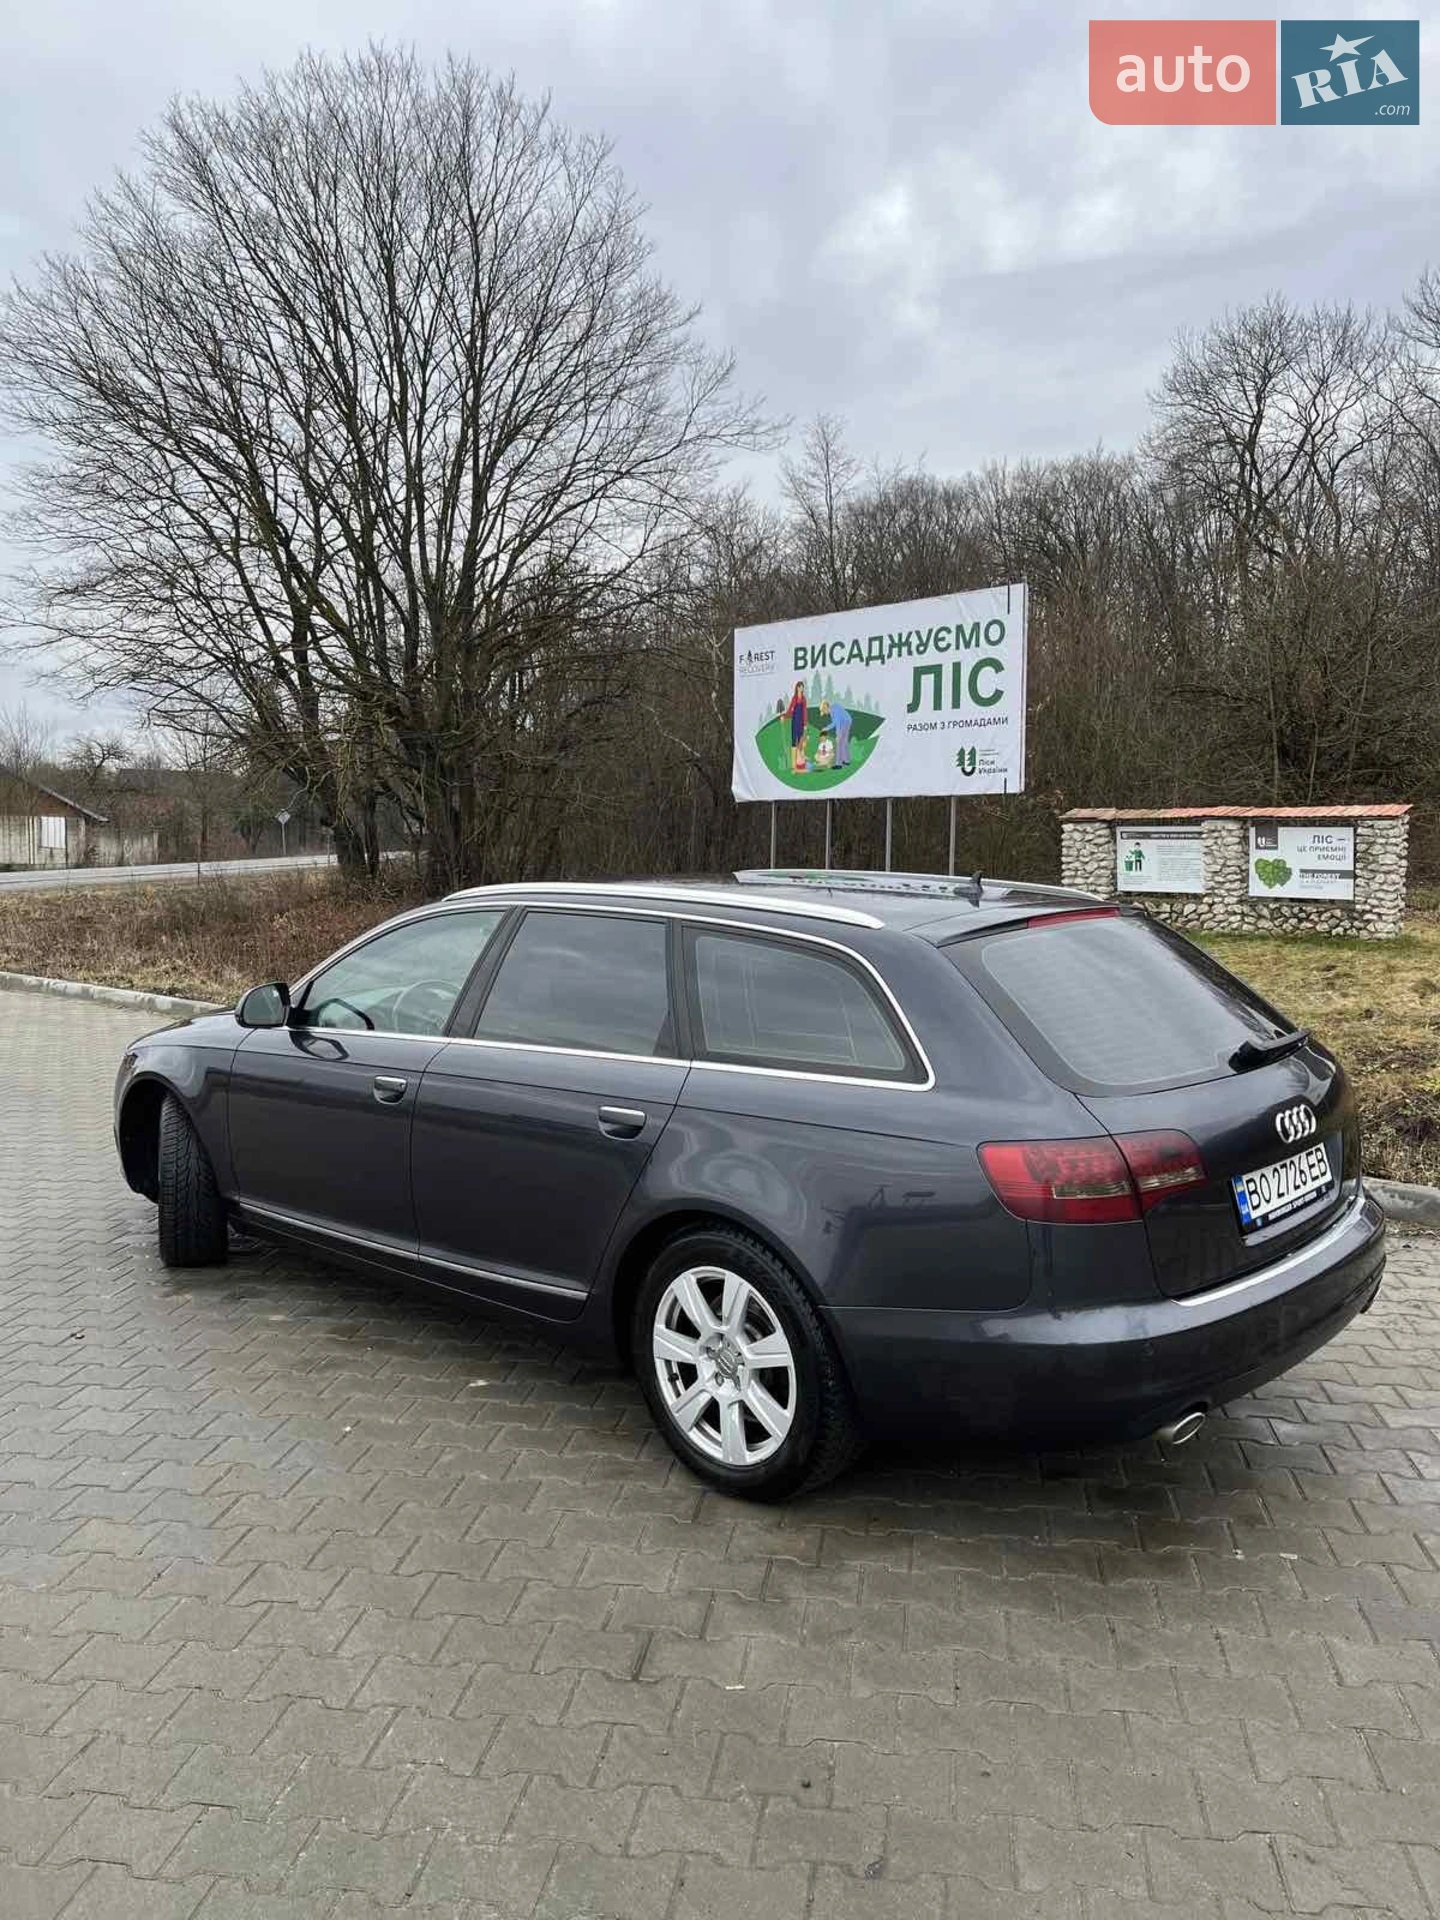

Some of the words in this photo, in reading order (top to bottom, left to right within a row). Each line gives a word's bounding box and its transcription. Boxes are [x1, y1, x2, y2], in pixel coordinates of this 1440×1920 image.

[793, 618, 1006, 671] ВИСАДЖУЄМО
[906, 657, 1005, 714] ЛІС
[907, 722, 938, 732] РАЗОМ
[948, 716, 1009, 729] ГРОМАДАМИ
[1312, 834, 1334, 844] ЛІС
[1246, 1174, 1272, 1211] BO
[1273, 1155, 1307, 1198] 2726
[1305, 1147, 1328, 1183] EB
